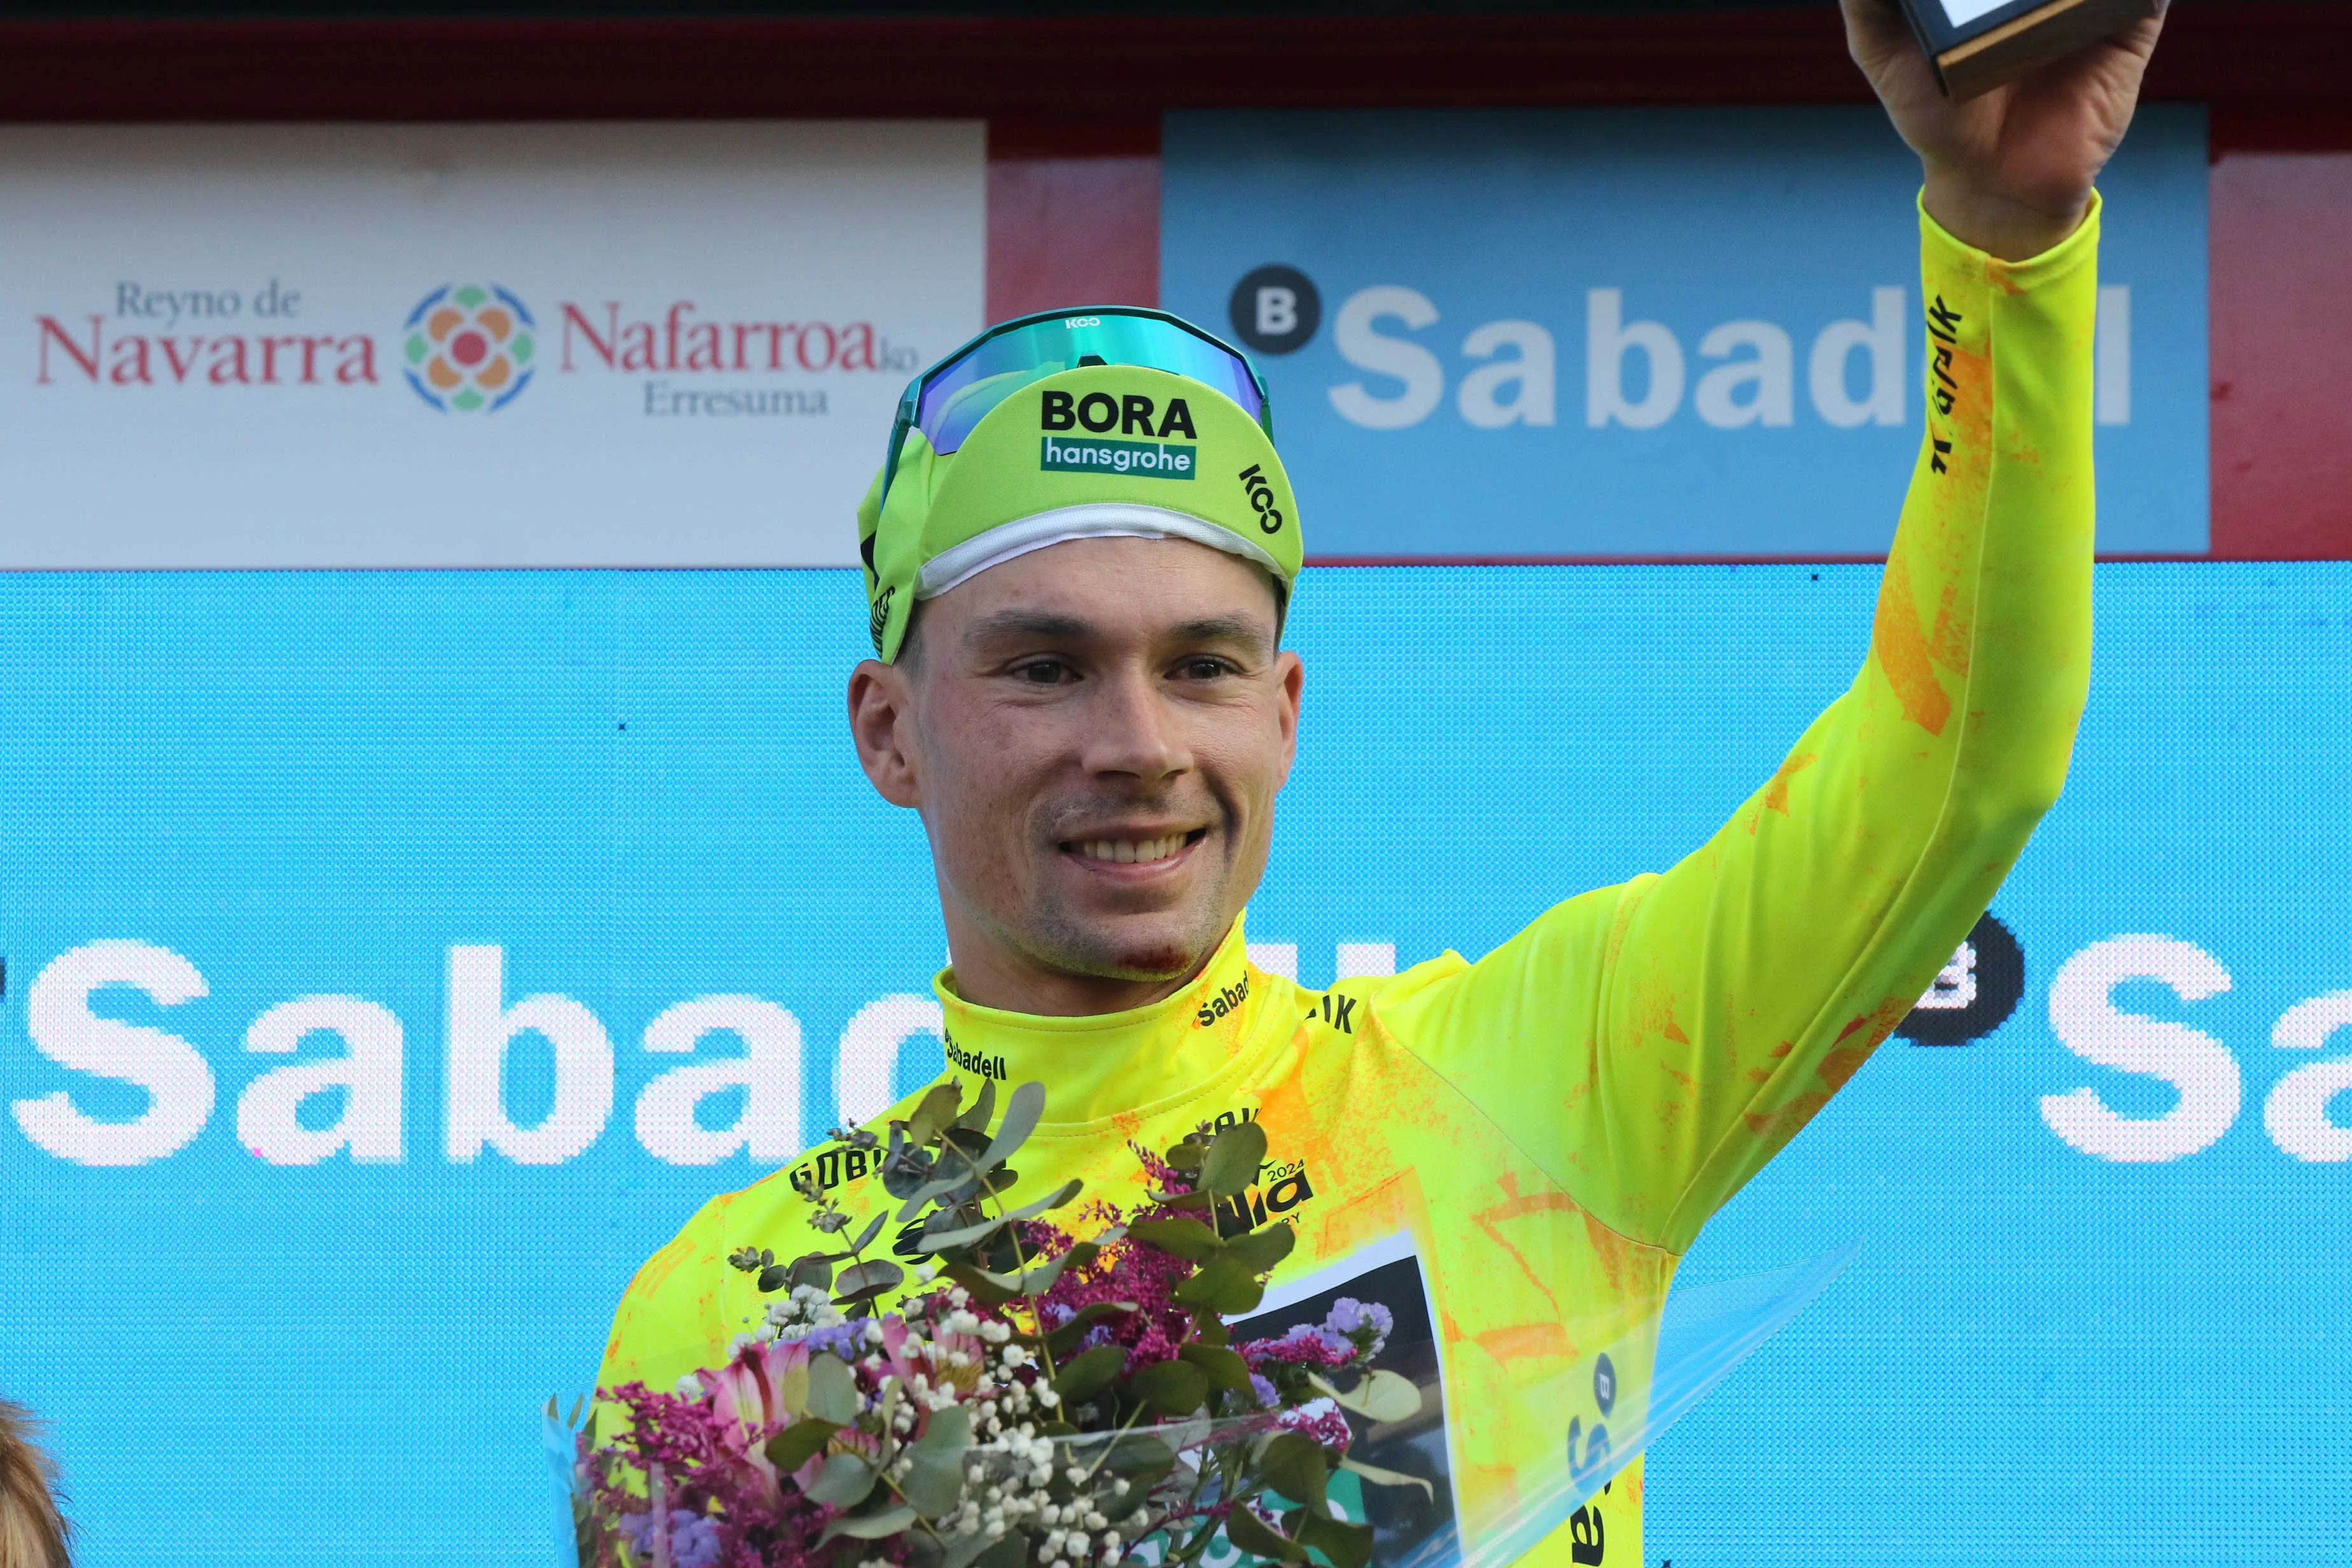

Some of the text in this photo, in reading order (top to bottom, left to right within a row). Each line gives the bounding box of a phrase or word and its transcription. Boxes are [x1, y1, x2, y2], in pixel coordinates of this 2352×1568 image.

[116, 278, 300, 328] Reyno de
[34, 314, 379, 385] Navarra
[1327, 284, 2131, 430] Sabadl
[643, 382, 829, 417] Erresuma
[1041, 390, 1198, 439] BORA
[1046, 439, 1191, 472] hansgrohe
